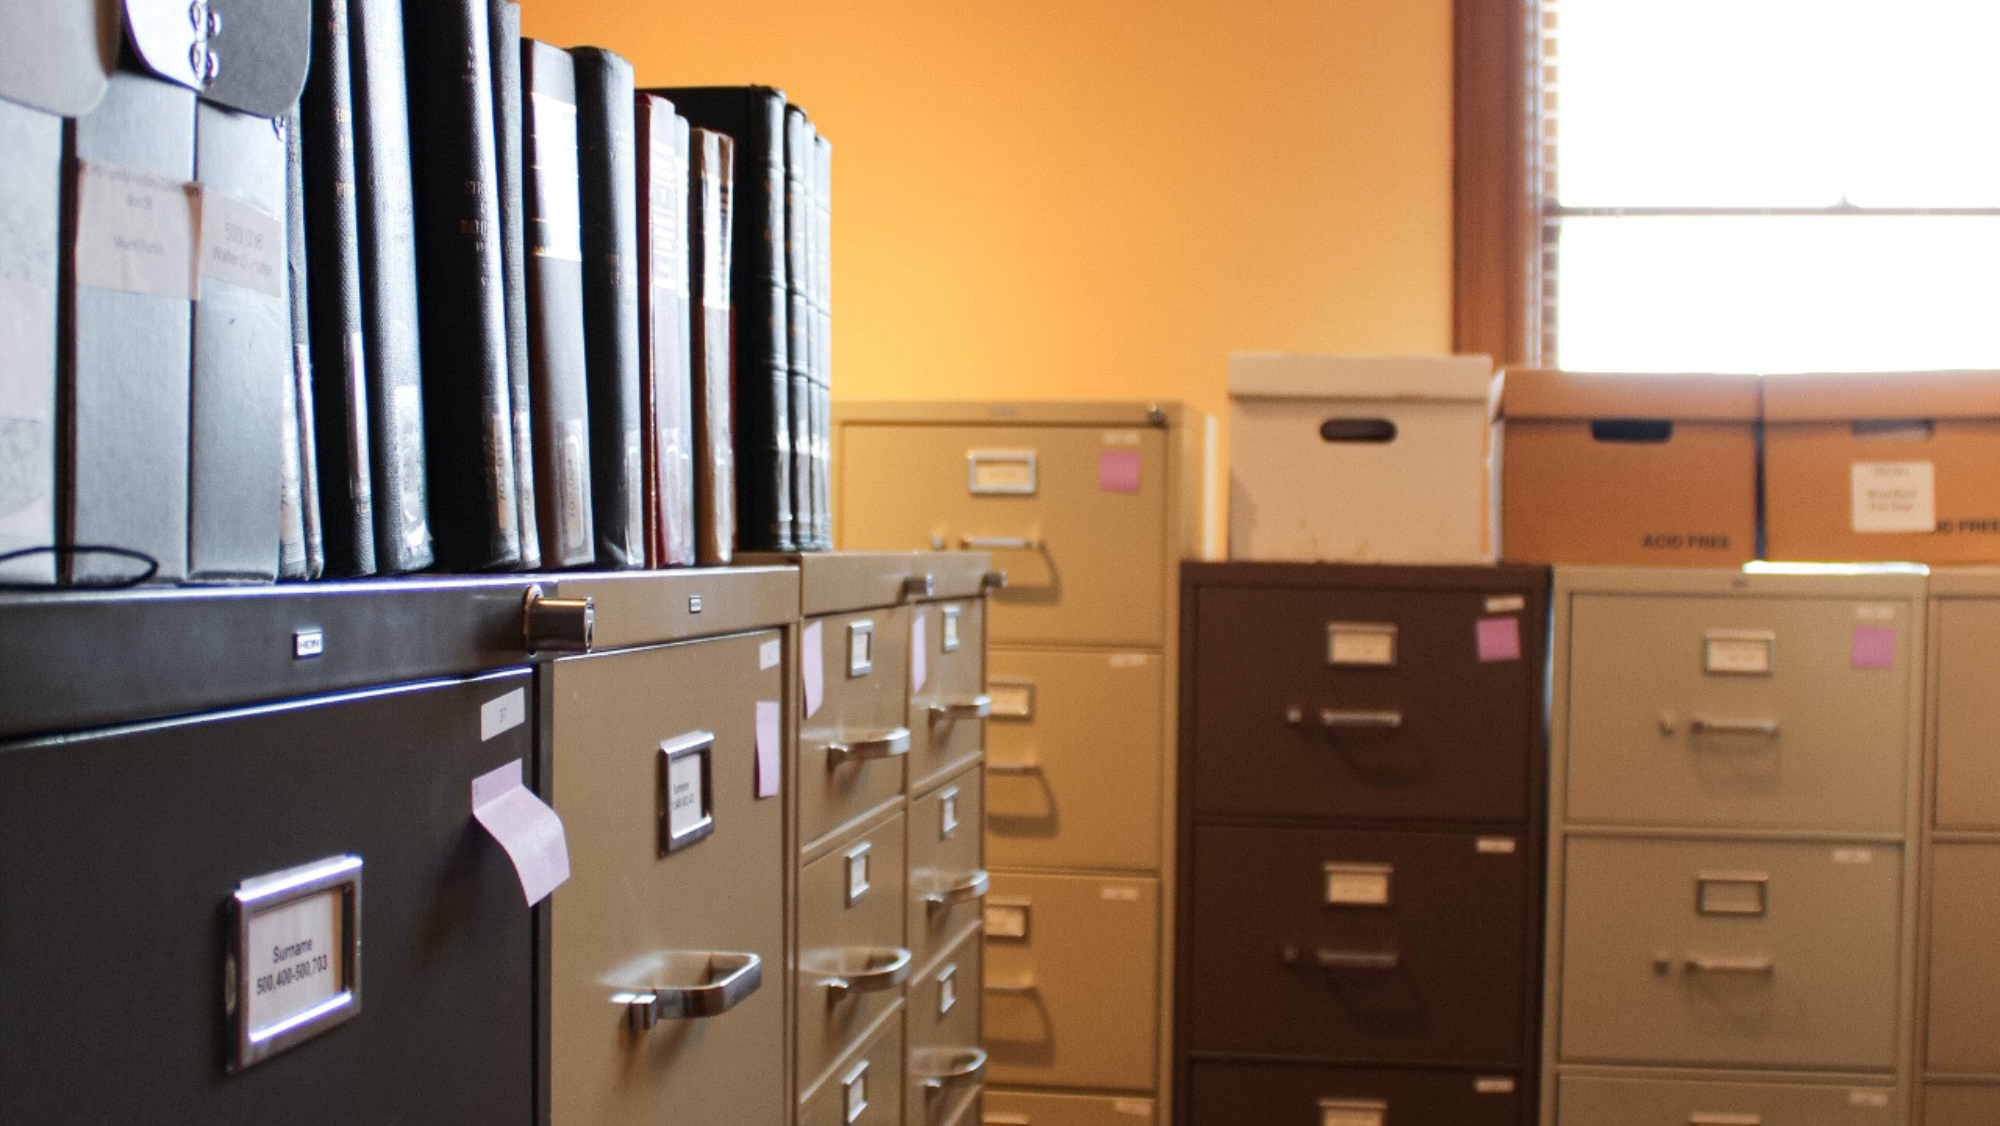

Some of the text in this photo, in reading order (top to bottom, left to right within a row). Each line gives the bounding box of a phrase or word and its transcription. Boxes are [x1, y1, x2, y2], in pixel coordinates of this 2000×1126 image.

[1937, 521, 1953, 534] ID
[1643, 534, 1730, 549] ACID FREE
[272, 939, 313, 964] Surname
